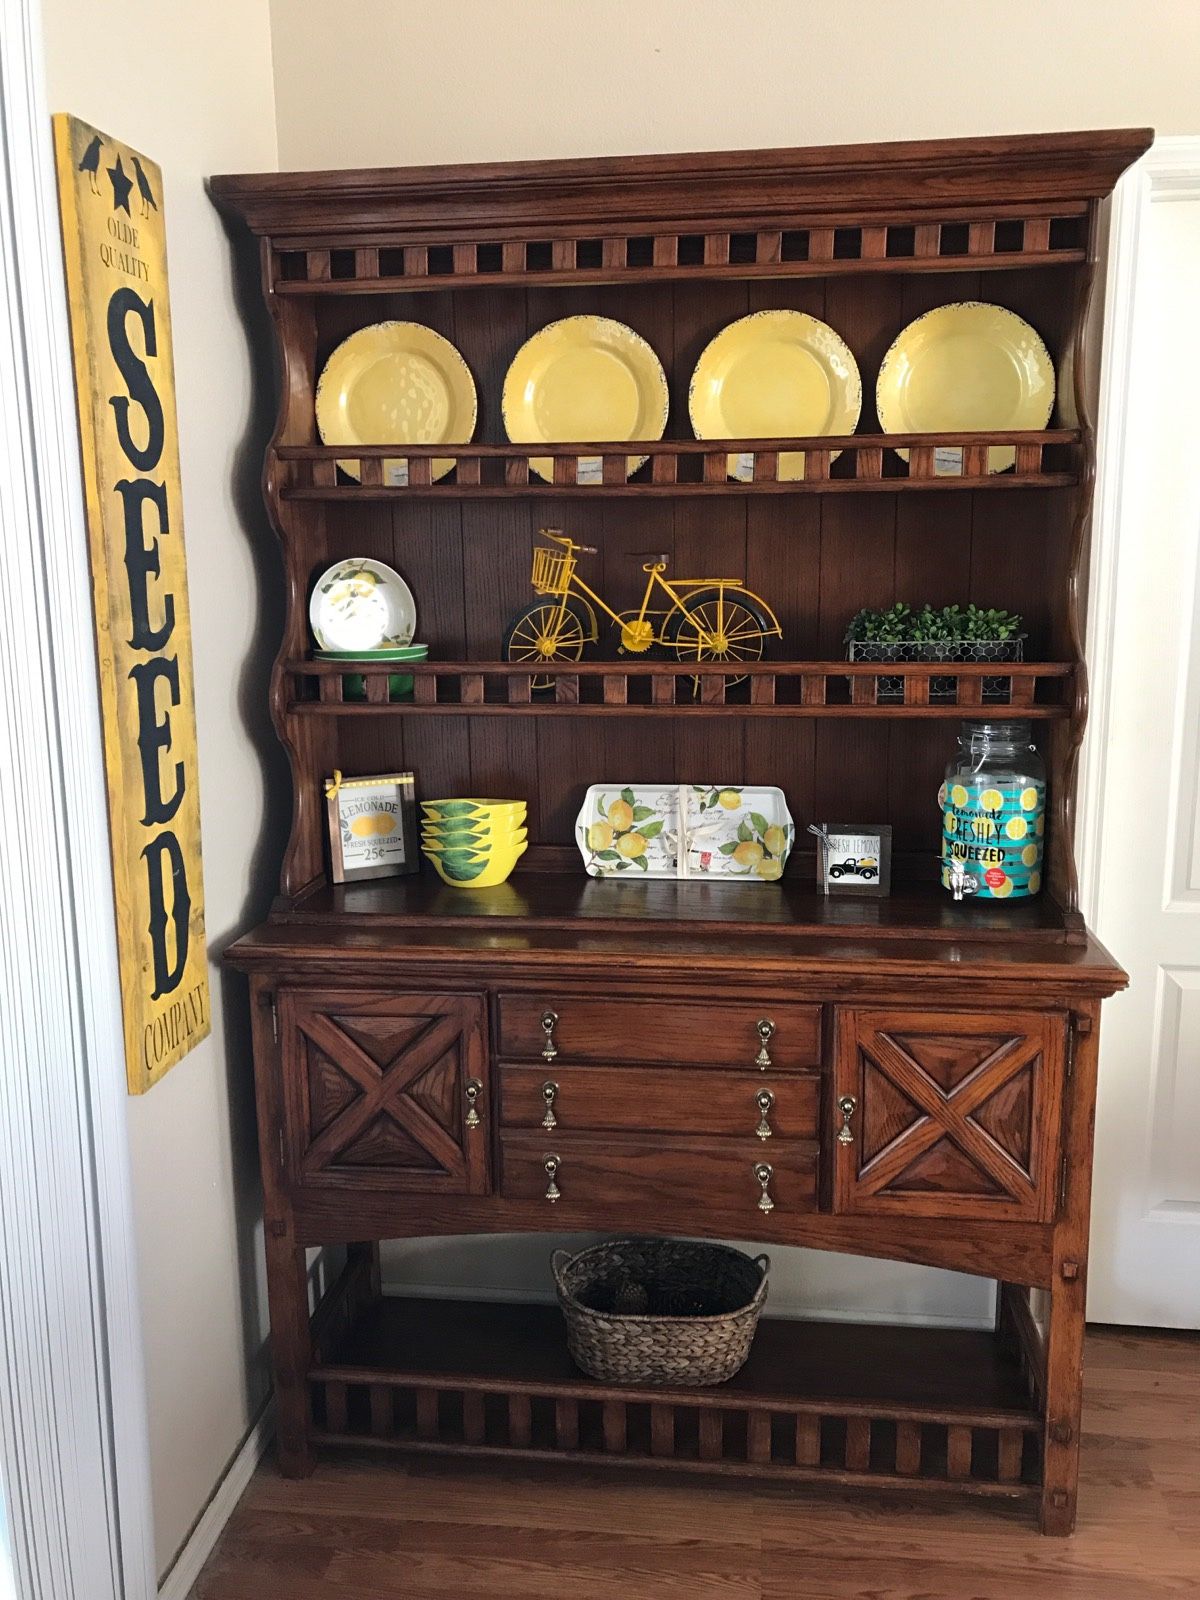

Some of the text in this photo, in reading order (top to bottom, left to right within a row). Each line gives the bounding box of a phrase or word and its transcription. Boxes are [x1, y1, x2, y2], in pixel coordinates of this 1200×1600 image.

[107, 216, 140, 249] OLDE
[100, 242, 149, 282] QUALITY
[107, 286, 192, 1001] SEED
[341, 801, 399, 820] LEMONADE
[950, 817, 1003, 846] FRESHLY
[364, 848, 385, 861] 25¢
[853, 839, 880, 855] LEMONS
[949, 841, 1006, 863] SQUEEZED
[144, 981, 205, 1071] COMPANY
